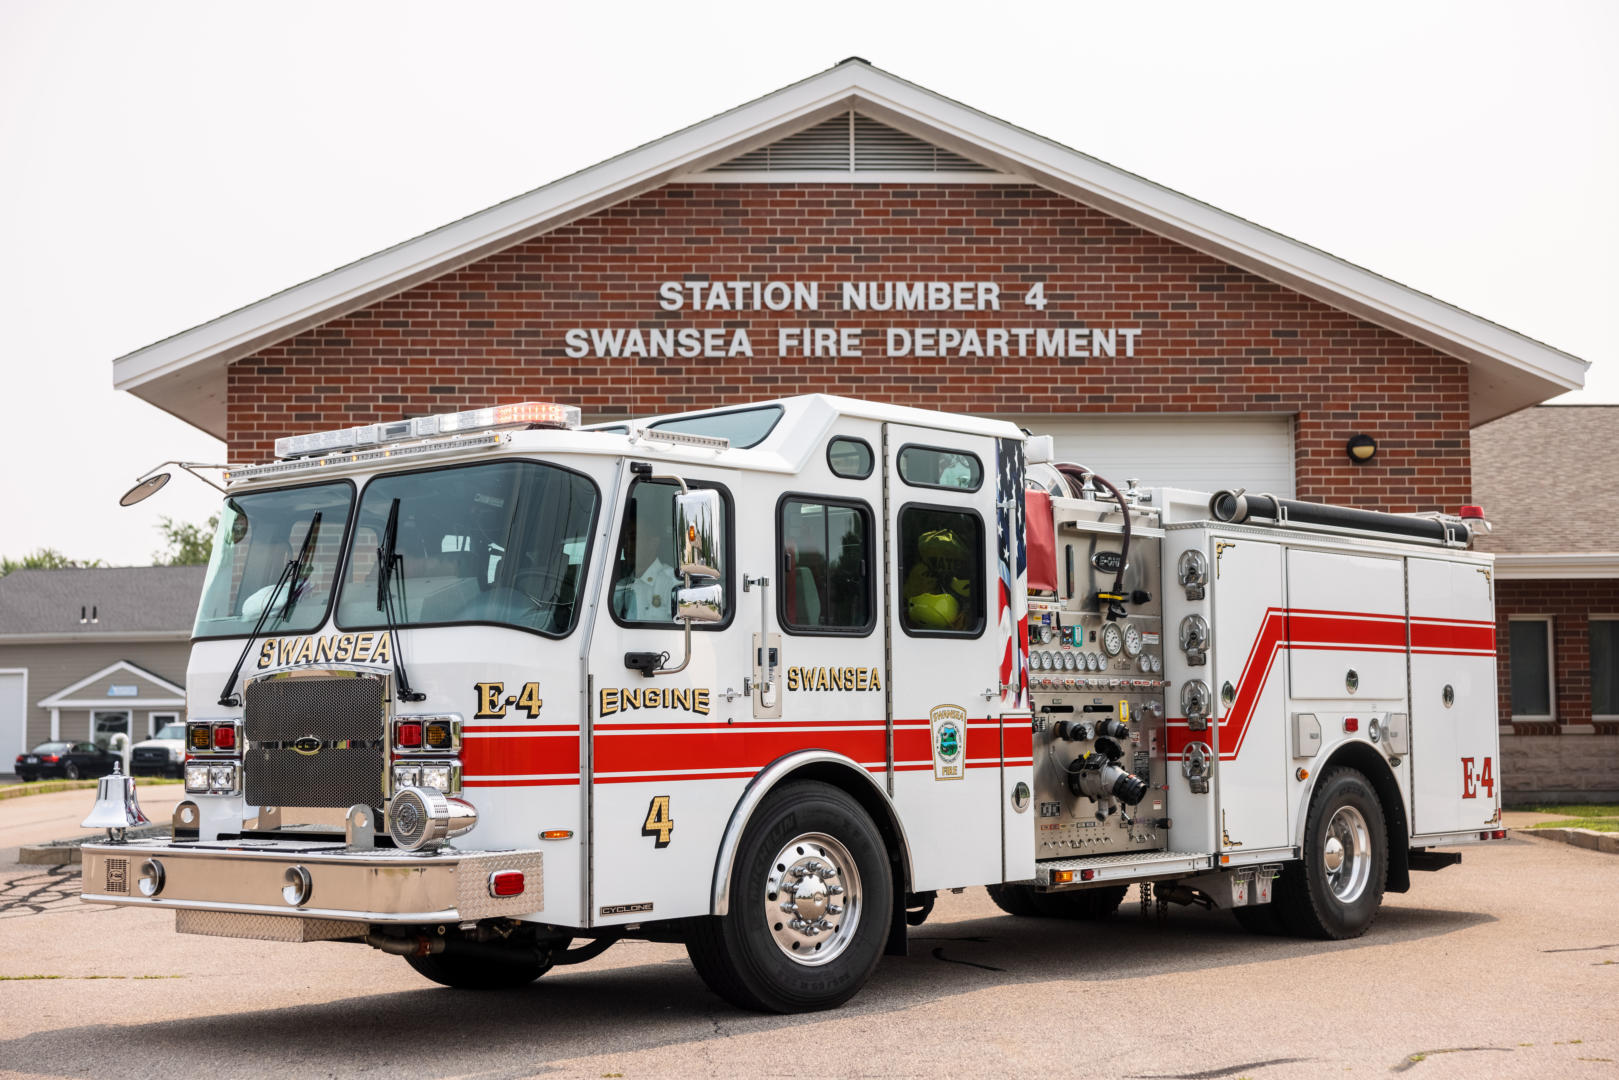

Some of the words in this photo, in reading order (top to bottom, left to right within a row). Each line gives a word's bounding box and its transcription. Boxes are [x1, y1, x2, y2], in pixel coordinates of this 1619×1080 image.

[658, 281, 819, 312] STATION
[842, 281, 1000, 312] NUMBER
[1023, 281, 1048, 312] 4
[564, 327, 754, 359] SWANSEA
[777, 327, 862, 359] FIRE
[886, 327, 1142, 359] DEPARTMENT
[257, 632, 393, 669] SWANSEA
[787, 666, 881, 692] SWANSEA
[473, 681, 543, 720] E-4
[599, 687, 711, 718] ENGINE
[933, 709, 964, 722] SWANSEA
[942, 766, 958, 776] FIRE
[1461, 756, 1494, 799] E-4
[641, 795, 674, 849] 4
[601, 903, 653, 915] CYCLONE
